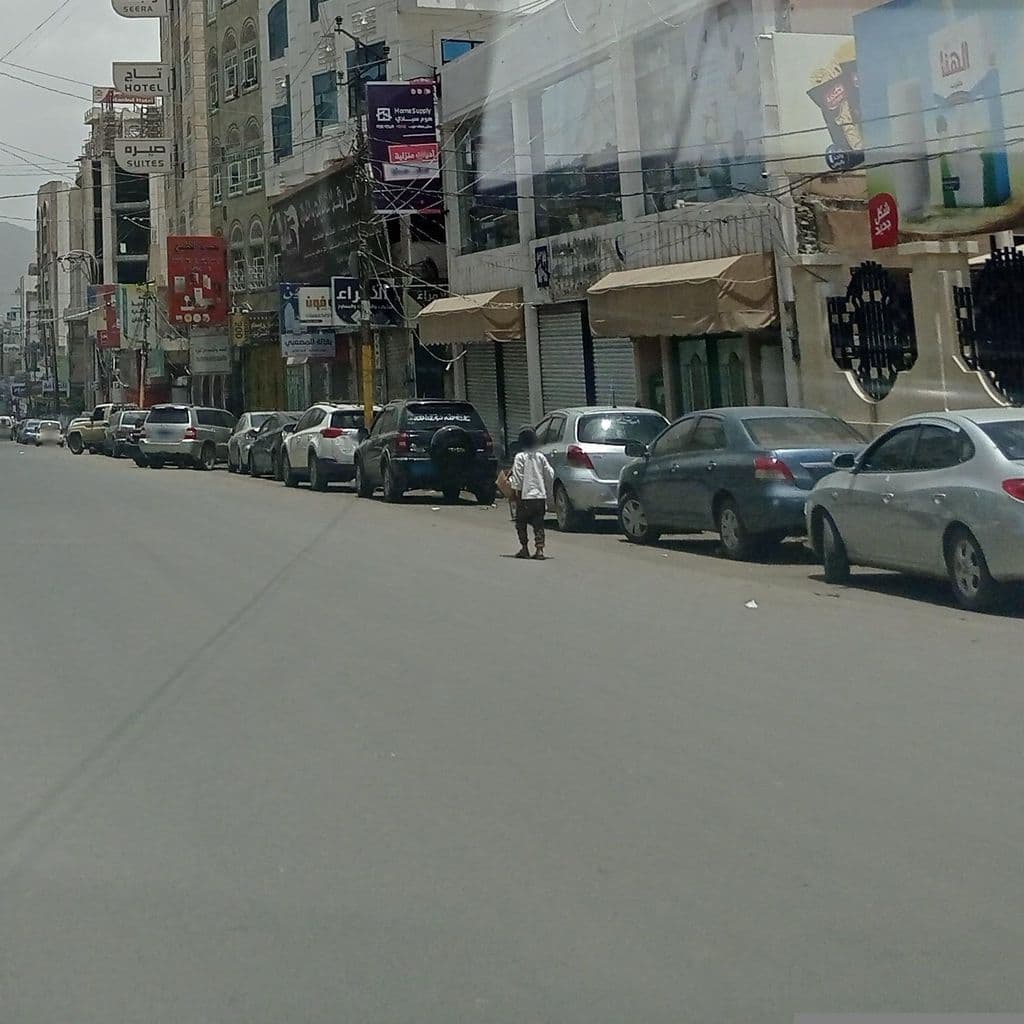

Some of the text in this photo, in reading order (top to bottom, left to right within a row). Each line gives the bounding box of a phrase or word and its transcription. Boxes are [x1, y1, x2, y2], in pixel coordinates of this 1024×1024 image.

[123, 5, 153, 13] SEERA
[124, 68, 162, 82] تاج
[124, 83, 163, 92] HOTEL
[126, 159, 165, 168] SUITES
